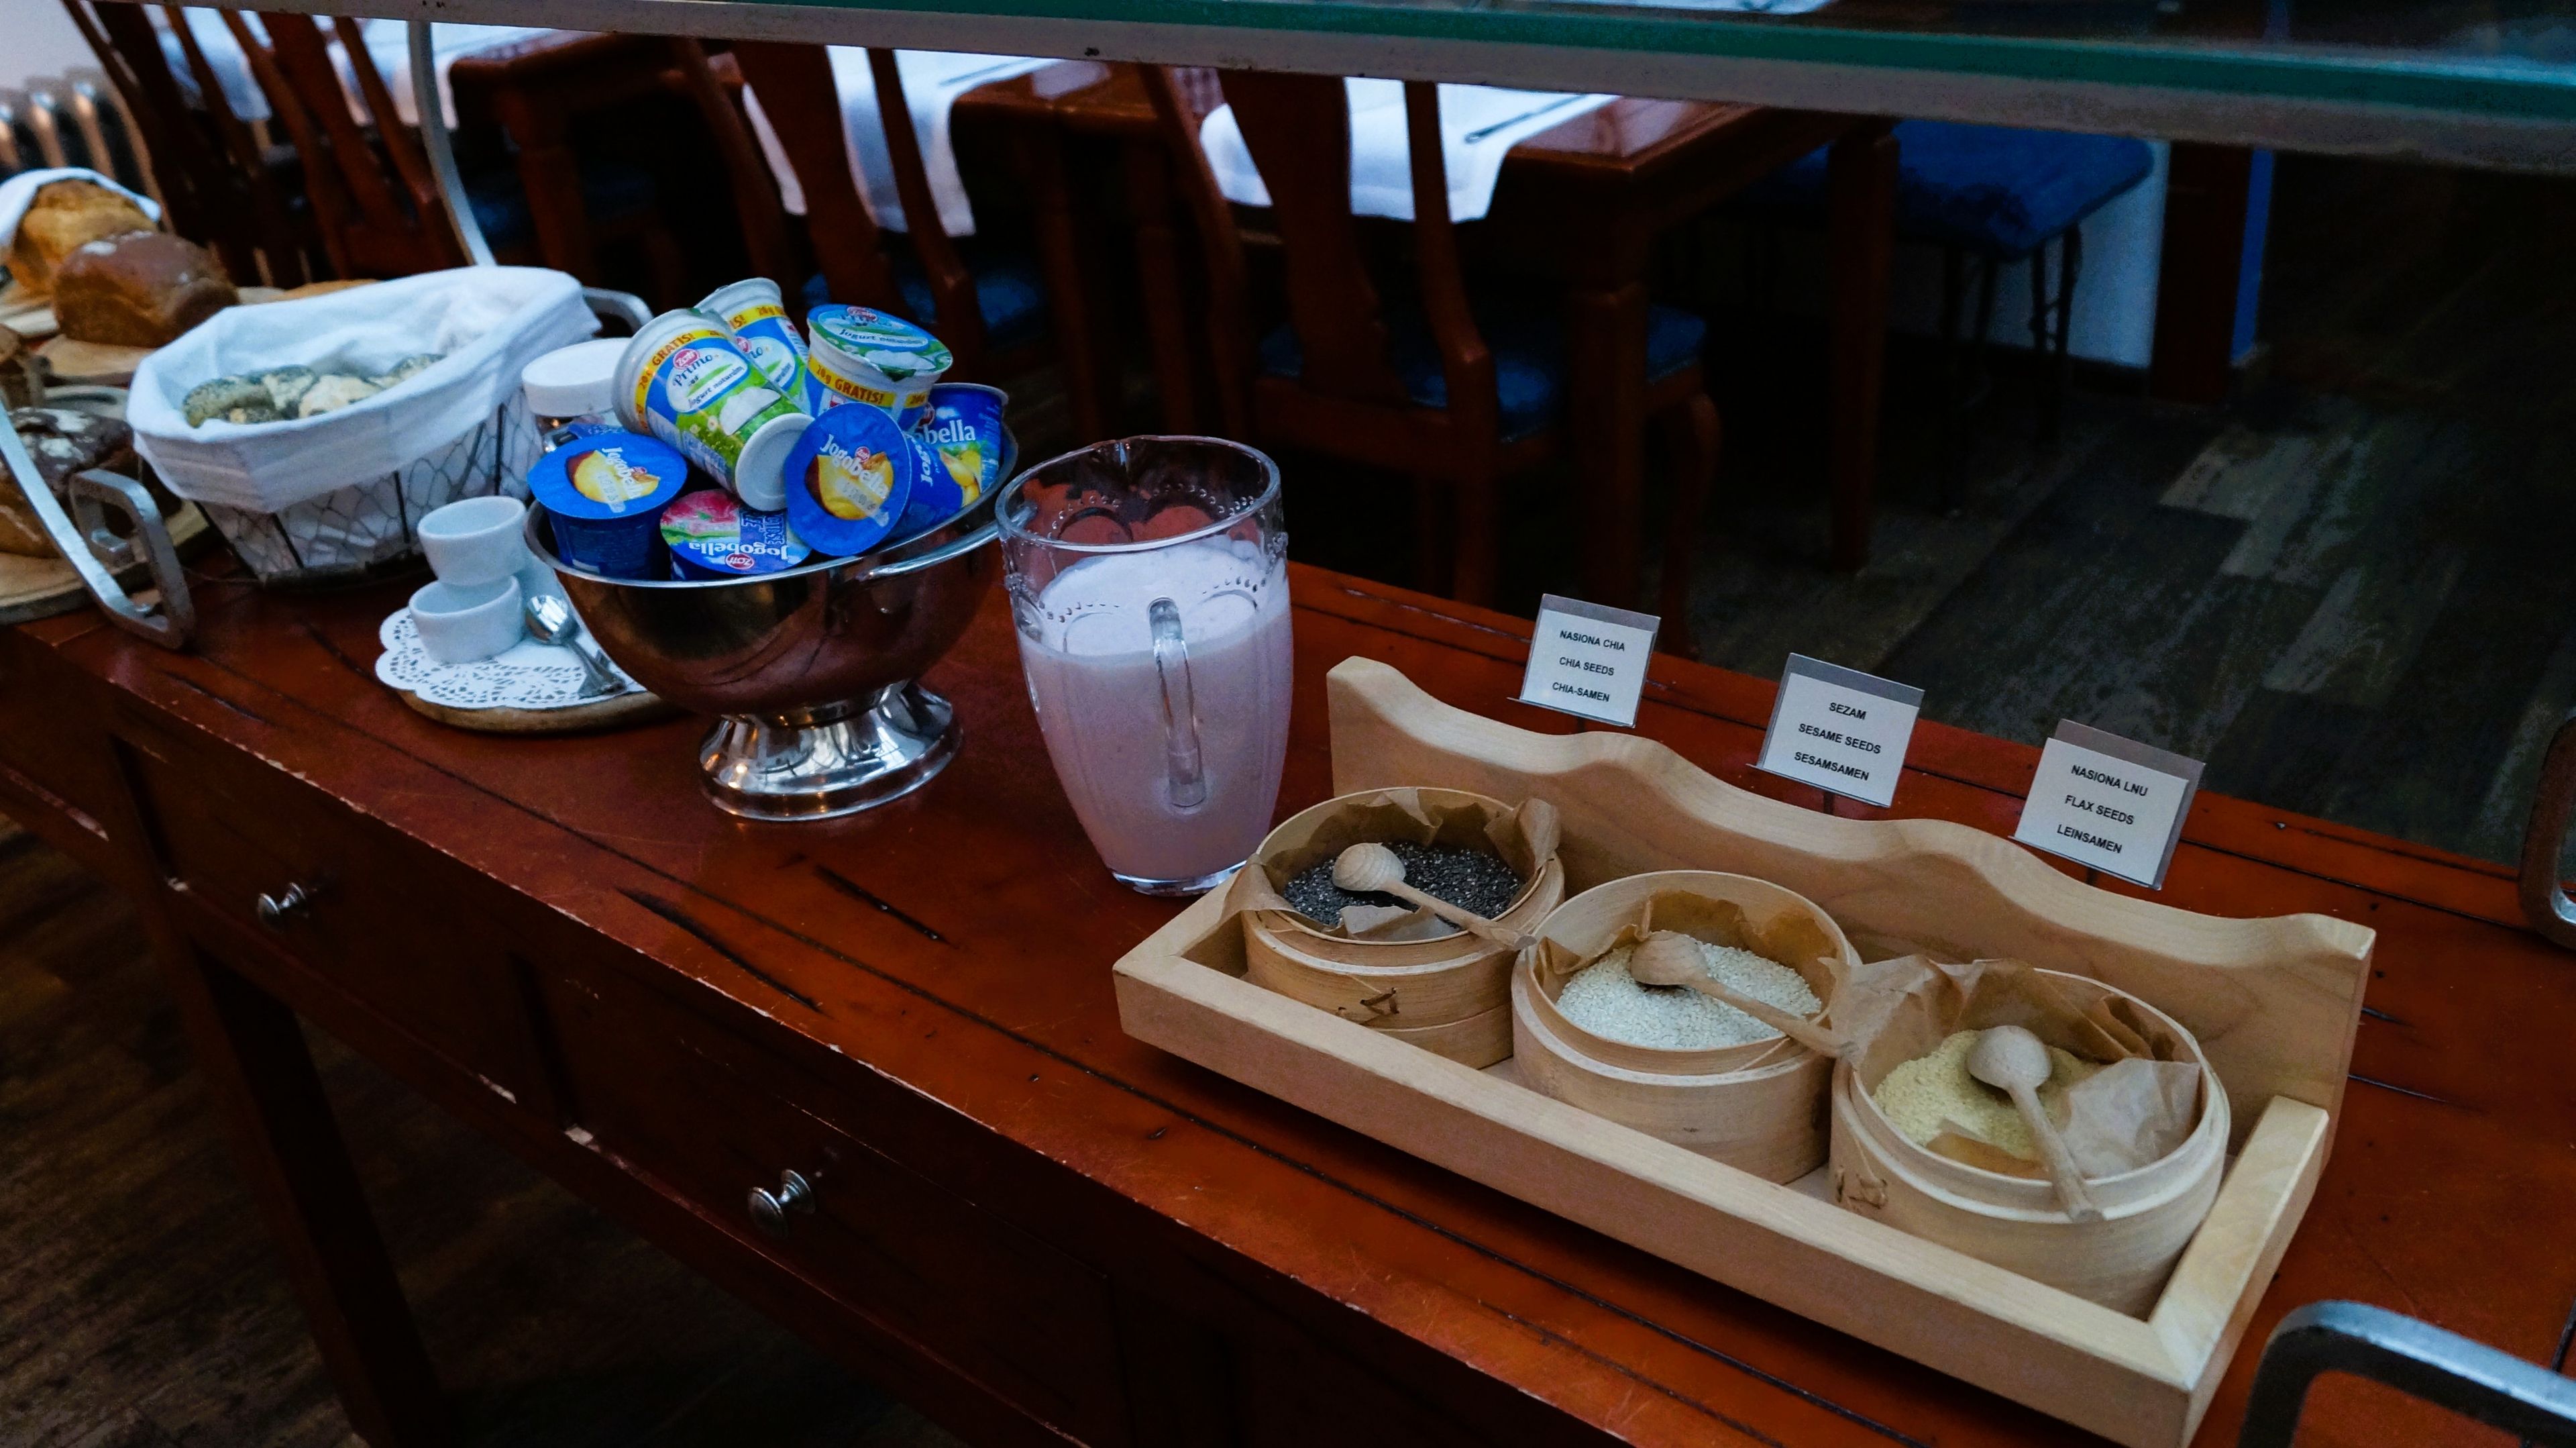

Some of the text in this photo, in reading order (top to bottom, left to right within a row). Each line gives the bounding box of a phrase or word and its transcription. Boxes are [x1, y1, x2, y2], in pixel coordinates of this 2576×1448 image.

[652, 333, 696, 366] GRATIS!
[675, 350, 698, 366] Zott
[673, 354, 713, 387] Primo
[835, 378, 884, 405] GRATIS!
[819, 433, 890, 500] Jogobella
[688, 541, 790, 560] Jogobella
[728, 556, 753, 567] Zott
[1560, 629, 1625, 652] NASIONA CHIA
[1559, 656, 1615, 676] CHIA SEEDS
[1552, 682, 1610, 702] CHIA-SAMEN
[1829, 702, 1867, 720] SEZAM
[1799, 723, 1881, 754] SESAME SEEDS
[1794, 752, 1870, 781] SESAMSAMEN
[2071, 764, 2149, 796] NASIONA LNU
[2065, 794, 2135, 825] FLAX SEEDS
[2057, 824, 2123, 854] LEINSAMEN
